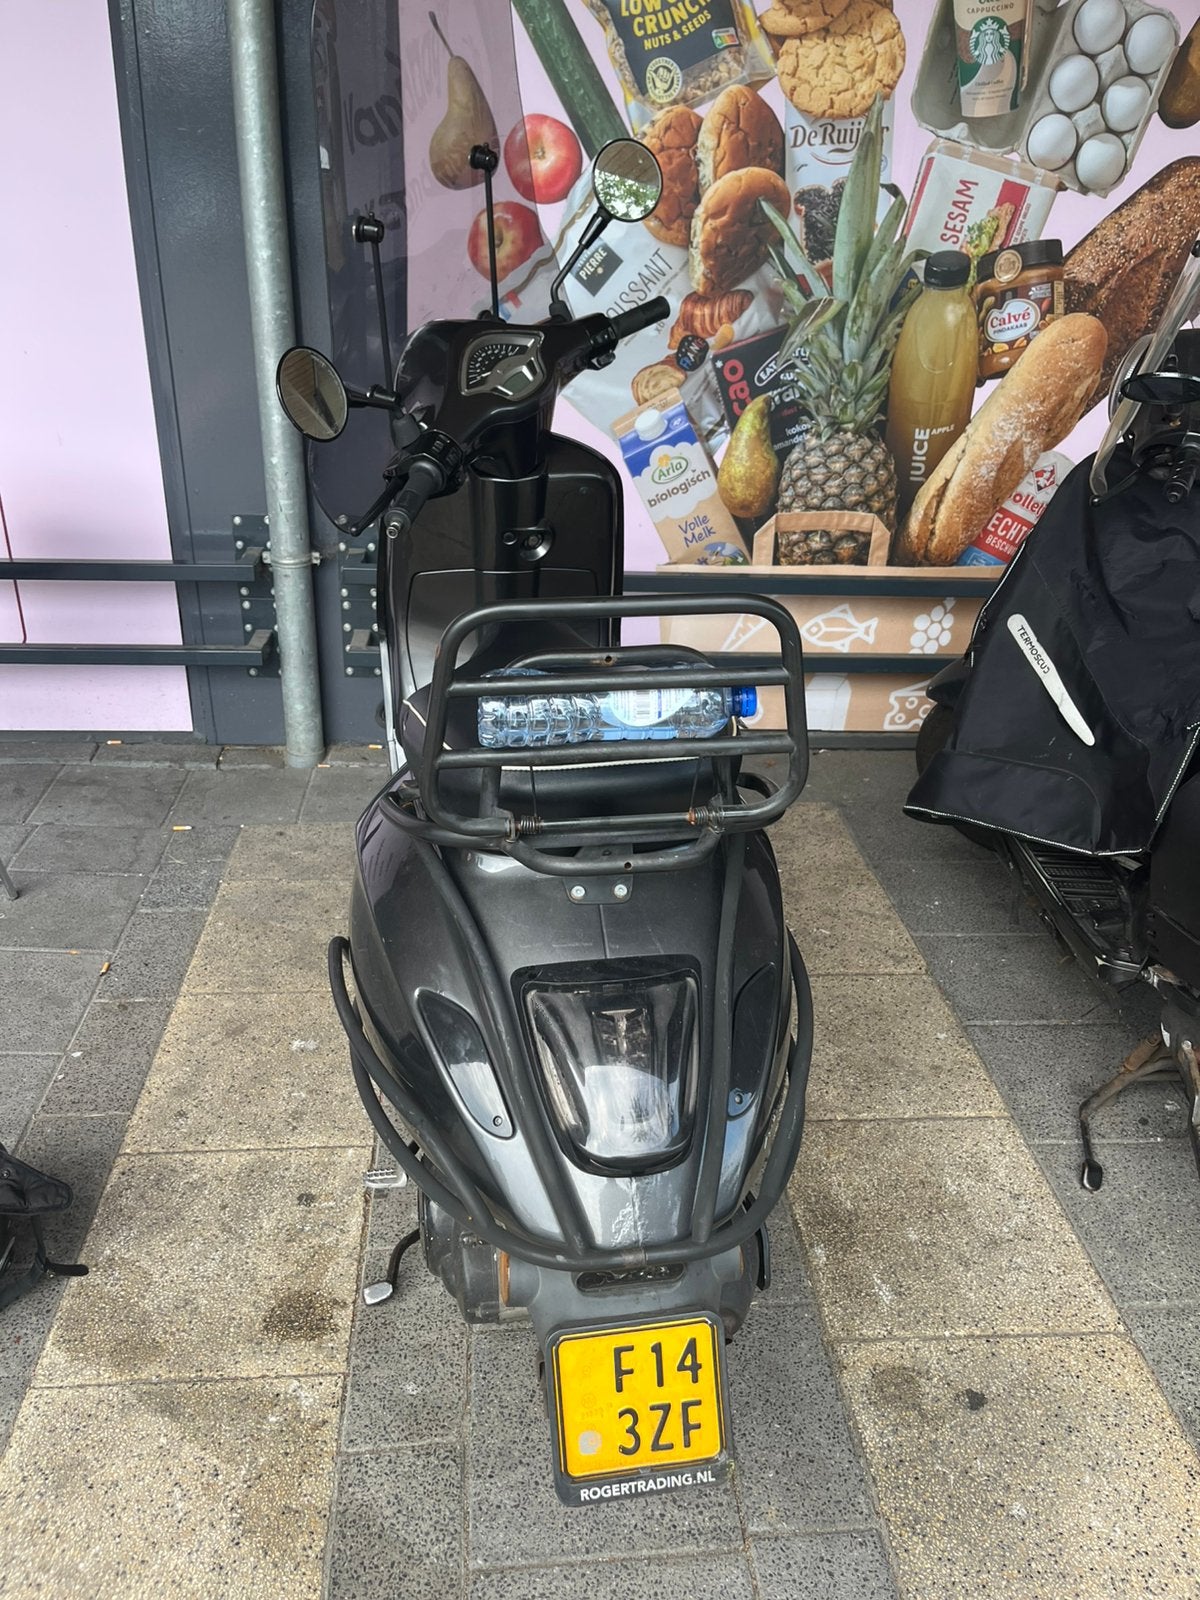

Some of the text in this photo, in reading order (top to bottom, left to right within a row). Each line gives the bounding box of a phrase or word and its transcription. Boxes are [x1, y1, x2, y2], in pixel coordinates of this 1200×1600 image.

[967, 3, 1014, 14] CAPPUCCINO
[644, 34, 671, 50] NUTS
[673, 30, 681, 41] &
[682, 10, 712, 36] SEEDS
[789, 124, 818, 149] De
[940, 179, 979, 245] SESAM
[578, 246, 608, 280] PIERRE
[990, 307, 1031, 329] Calvé
[759, 360, 779, 381] EAT
[931, 424, 955, 435] APPLE
[909, 428, 931, 482] JUICE
[657, 460, 683, 482] Arla
[647, 469, 711, 508] biologisch
[678, 515, 710, 535] Volle
[683, 526, 716, 548] Melk
[987, 512, 1028, 545] ECHT
[613, 1337, 702, 1393] F14
[618, 1399, 702, 1456] 3ZF
[579, 1470, 716, 1501] ROGERTRADING.NL
